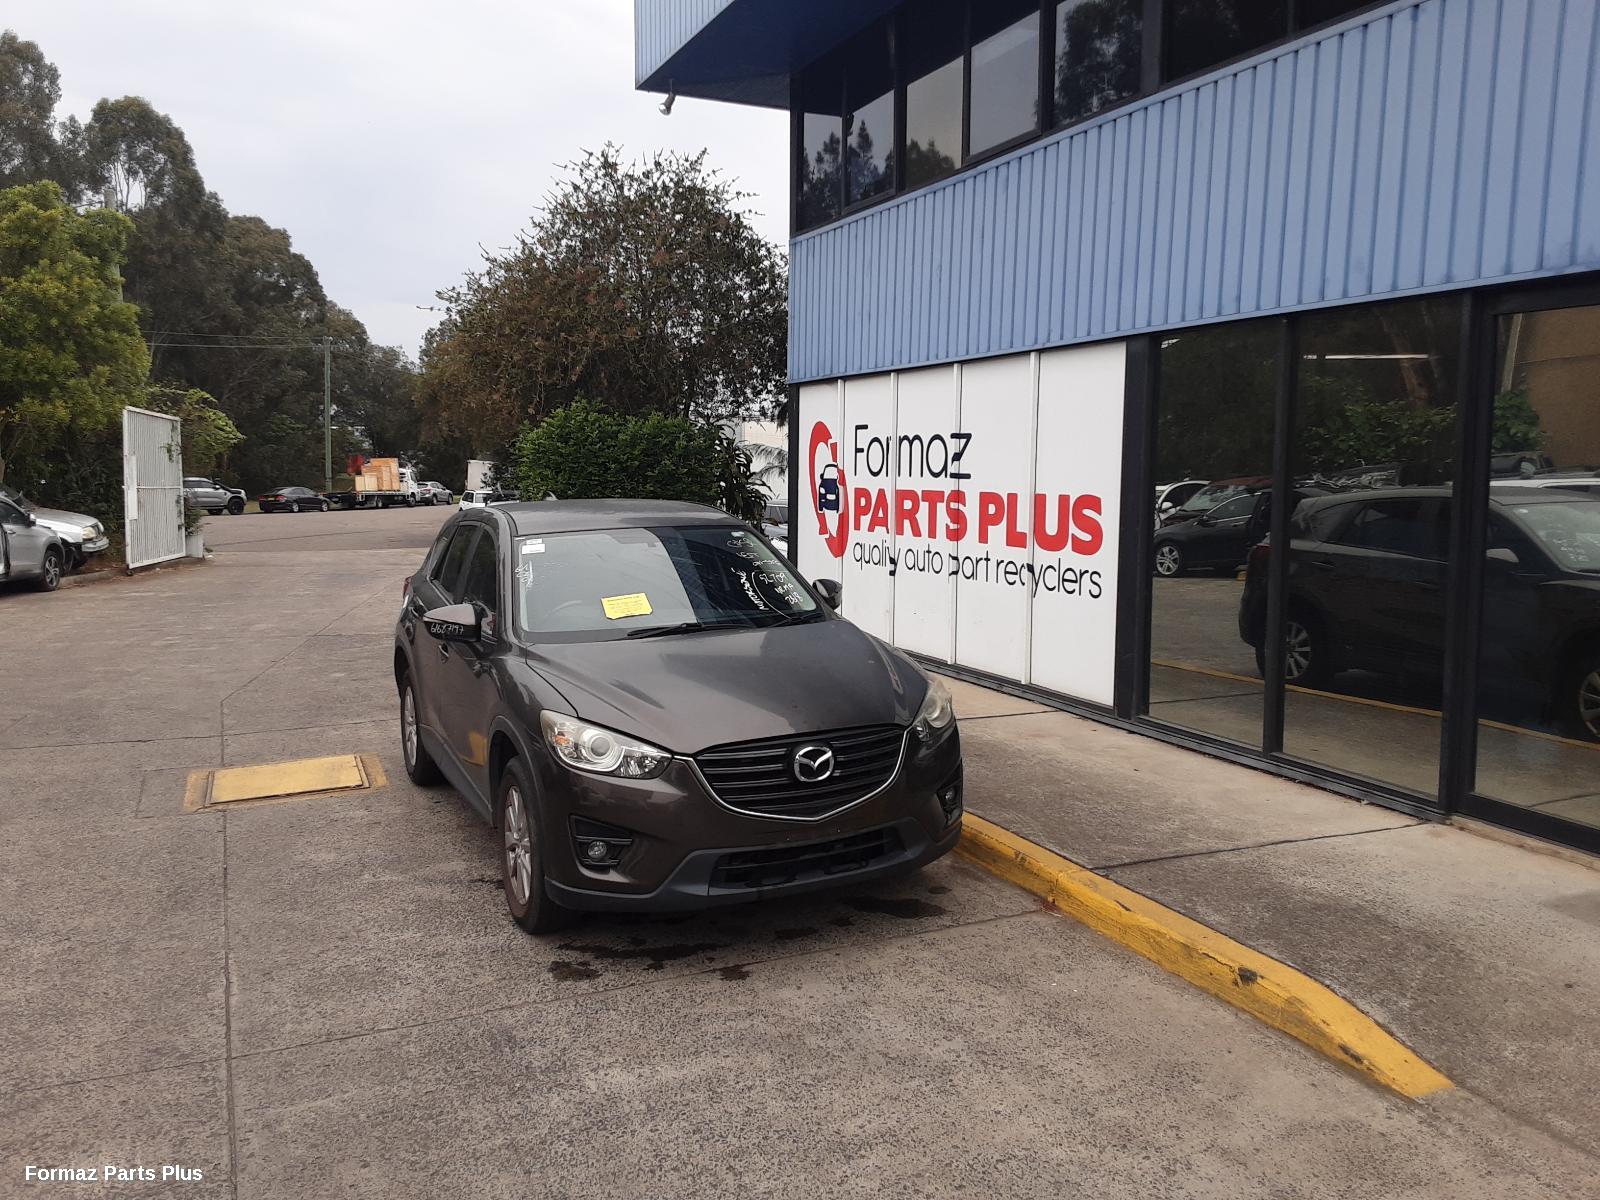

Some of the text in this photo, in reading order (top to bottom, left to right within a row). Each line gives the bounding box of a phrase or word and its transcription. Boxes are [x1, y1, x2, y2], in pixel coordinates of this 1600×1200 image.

[854, 424, 972, 479] Formaz
[853, 487, 1104, 556] PARTS PLUS
[853, 539, 1102, 599] qualiy auto part recyclers
